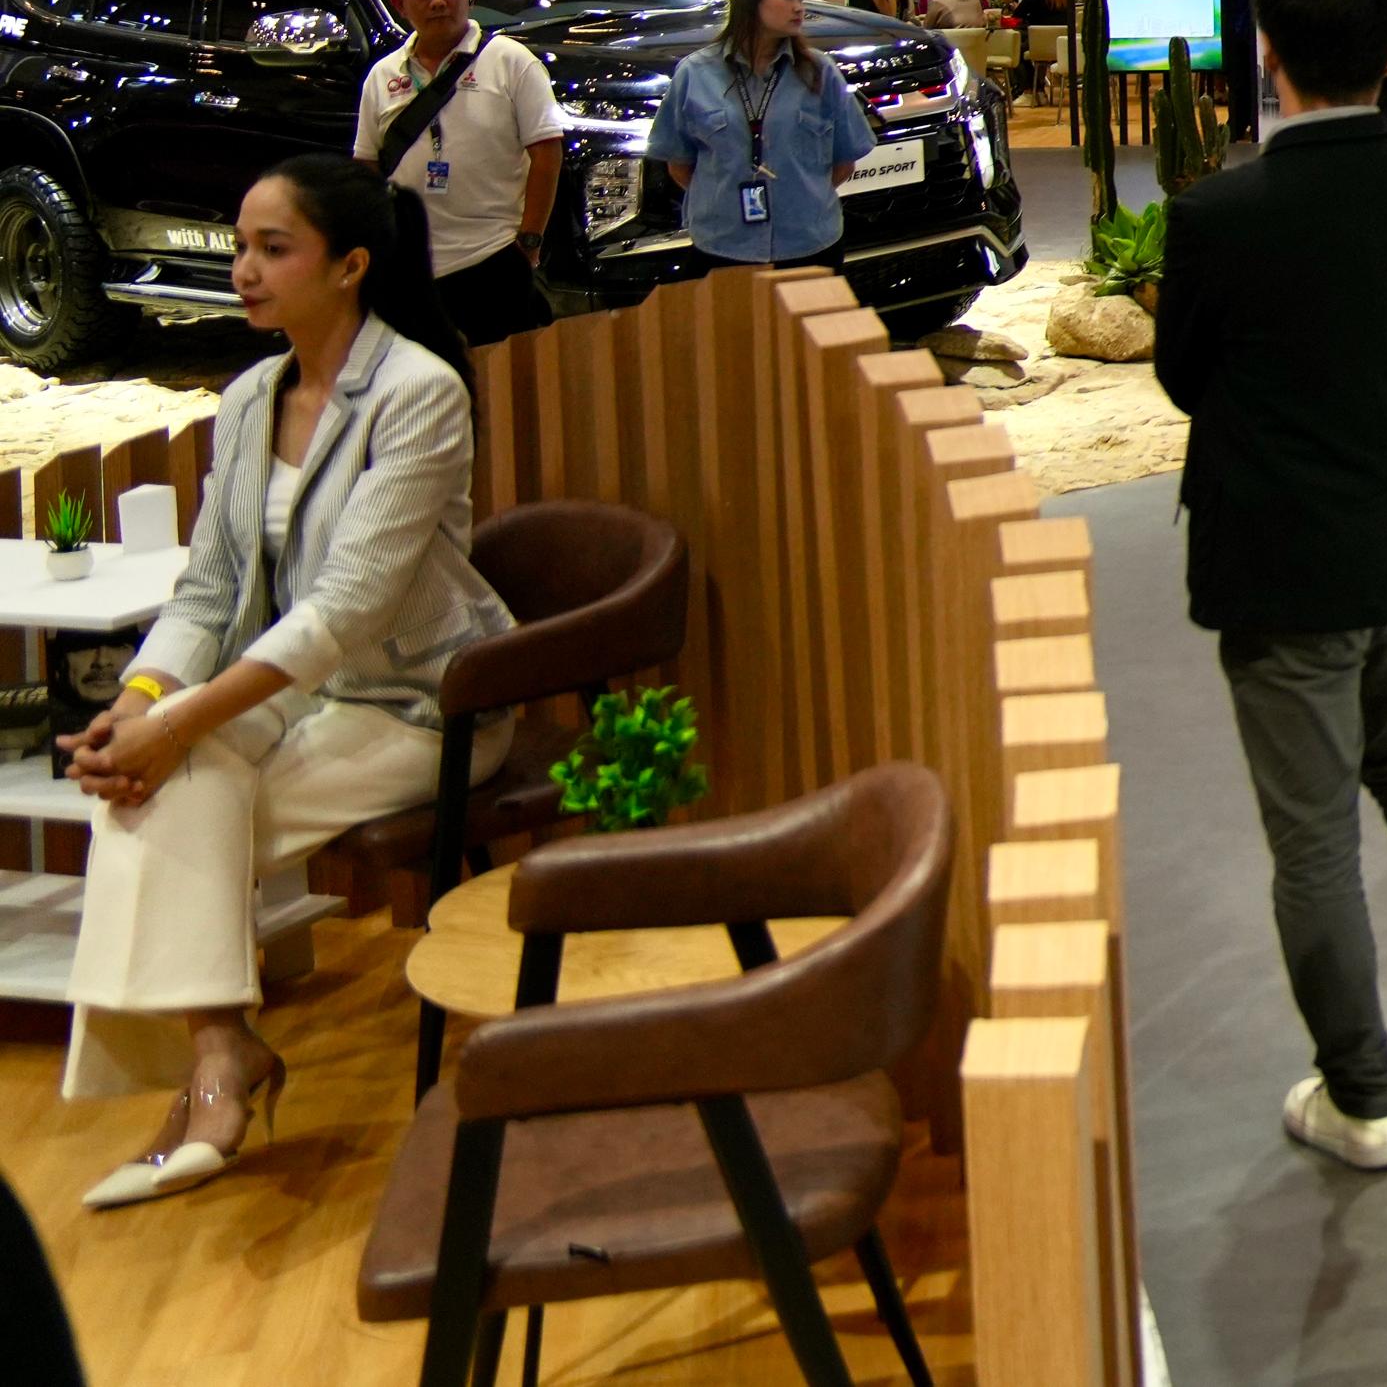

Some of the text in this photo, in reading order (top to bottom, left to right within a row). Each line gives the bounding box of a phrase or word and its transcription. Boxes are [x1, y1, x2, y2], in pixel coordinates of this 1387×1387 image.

[847, 160, 917, 183] JERO SPORT
[167, 228, 206, 247] with
